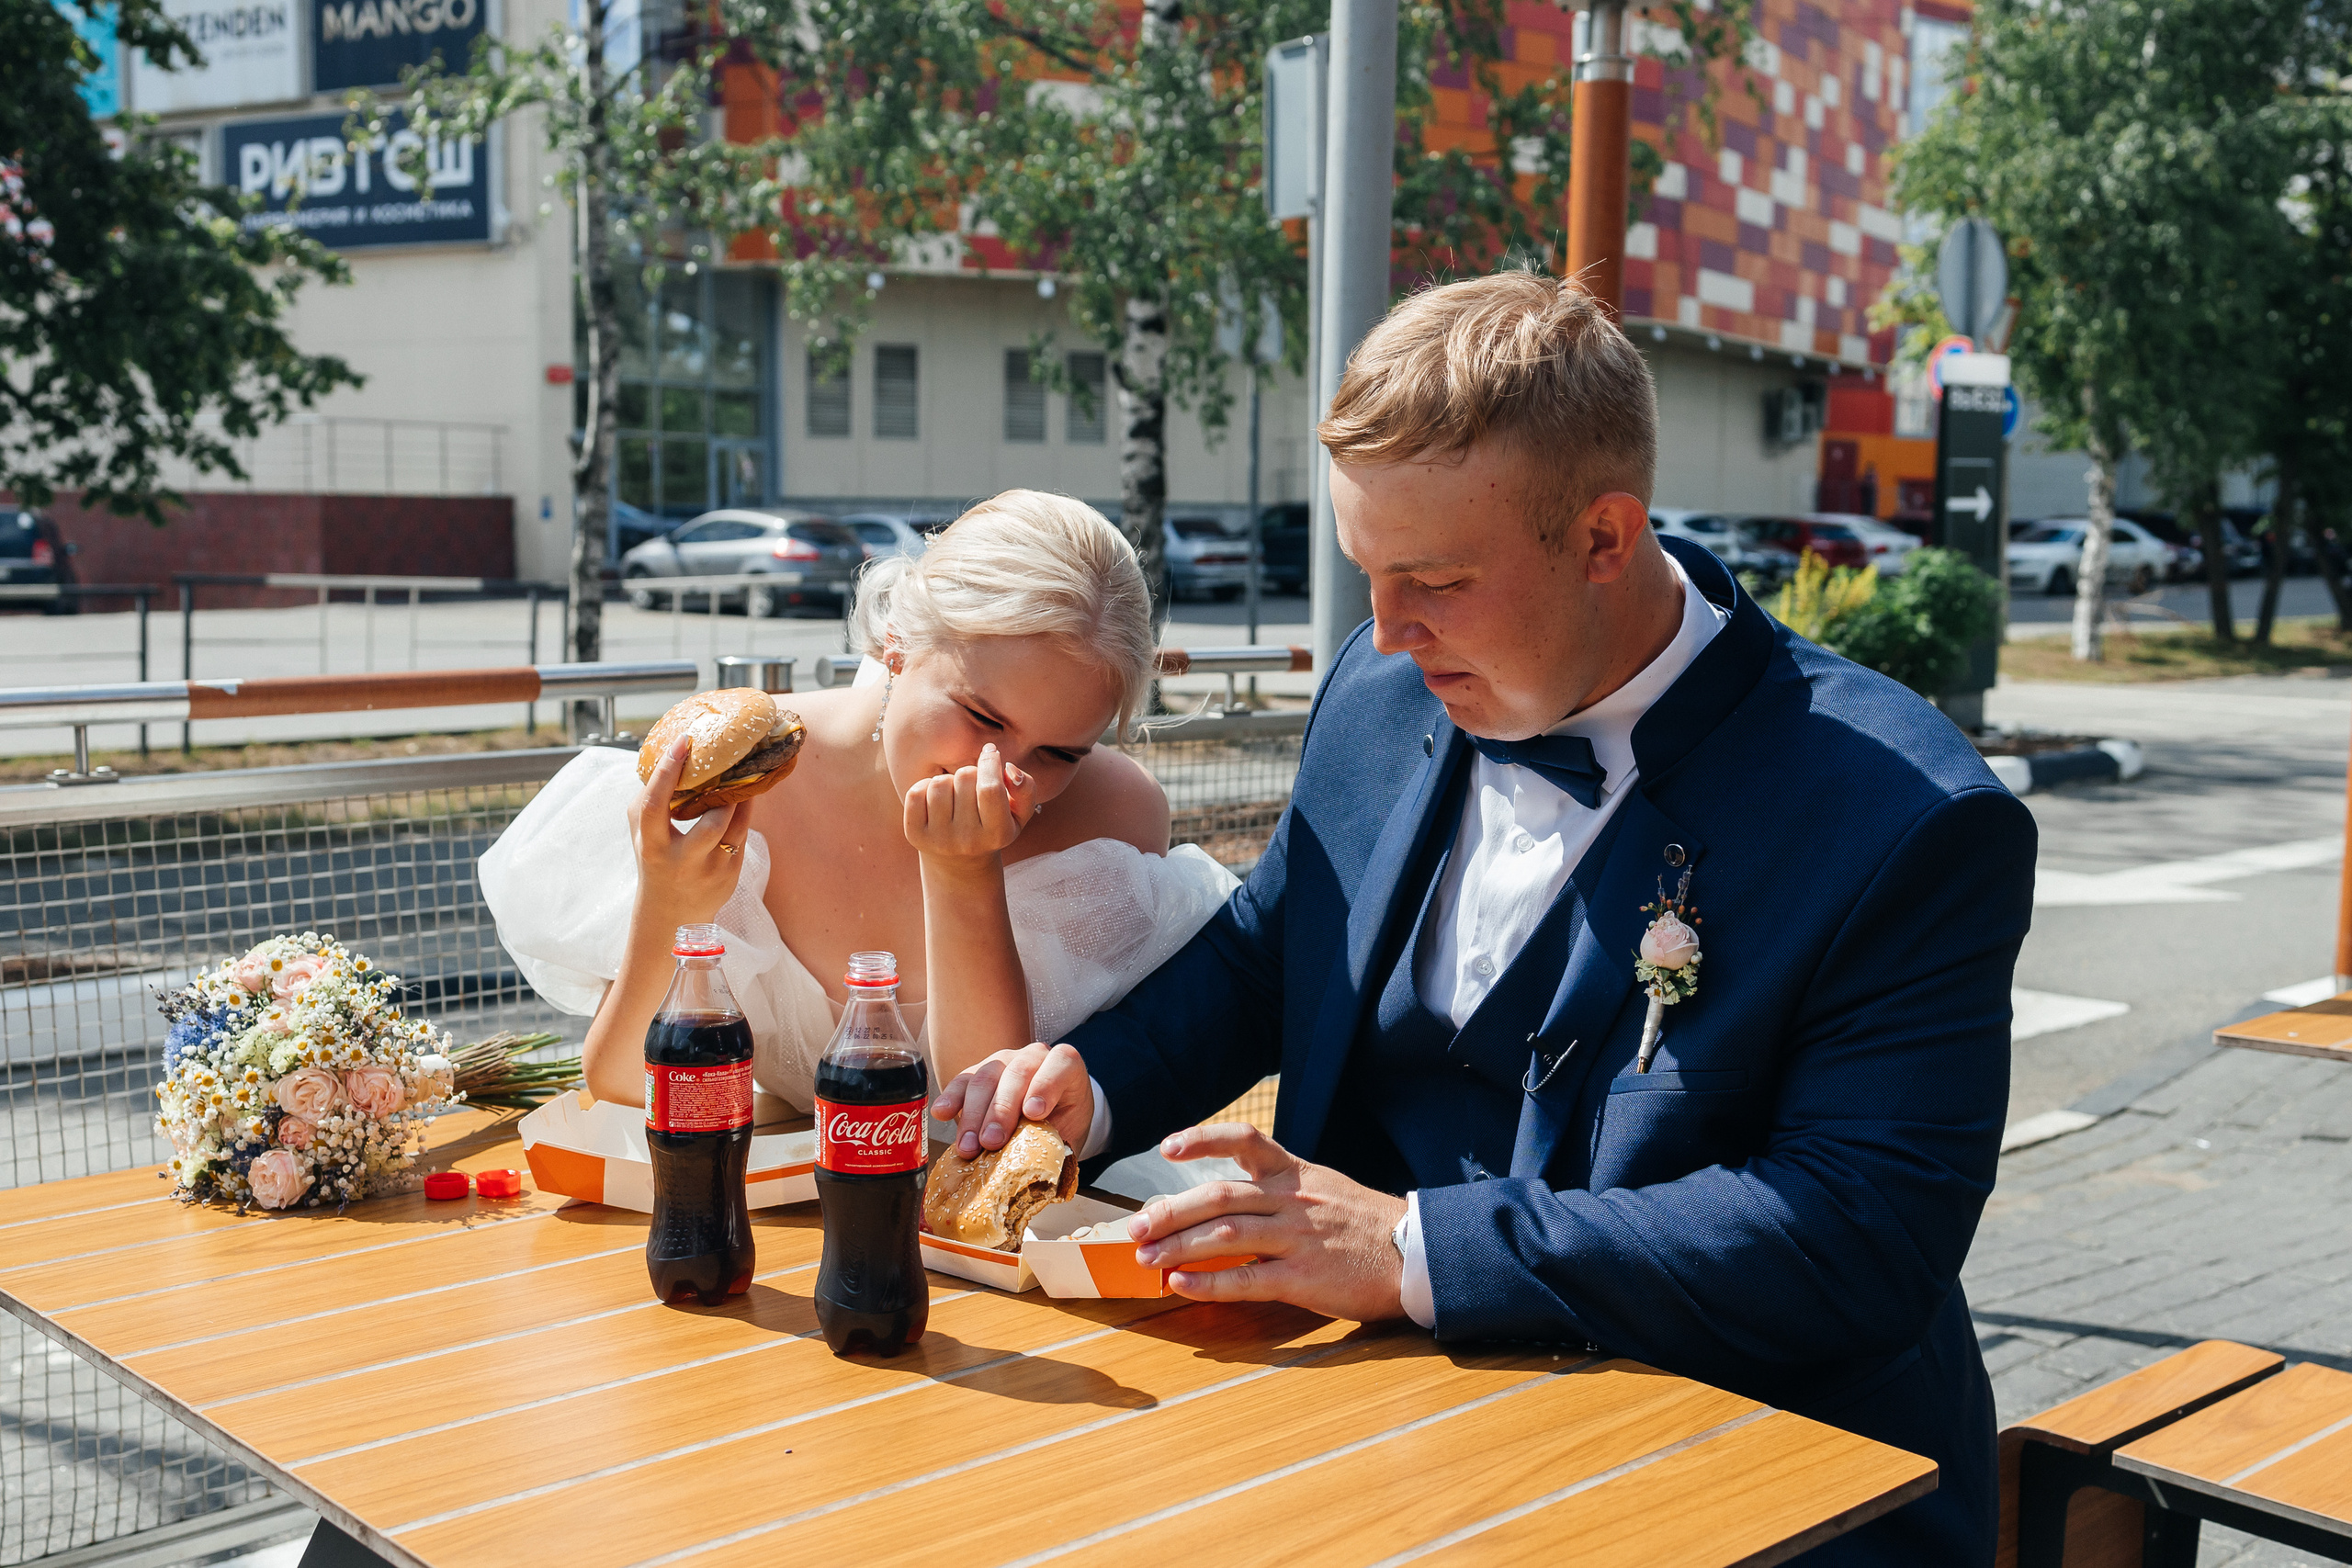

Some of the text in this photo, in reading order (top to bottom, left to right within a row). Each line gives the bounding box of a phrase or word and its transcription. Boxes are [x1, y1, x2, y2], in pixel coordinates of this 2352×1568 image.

[322, 0, 477, 42] MANGO
[669, 1070, 696, 1083] Coke
[828, 1109, 922, 1147] Coca-Cola
[857, 1148, 892, 1156] CLASSIC
